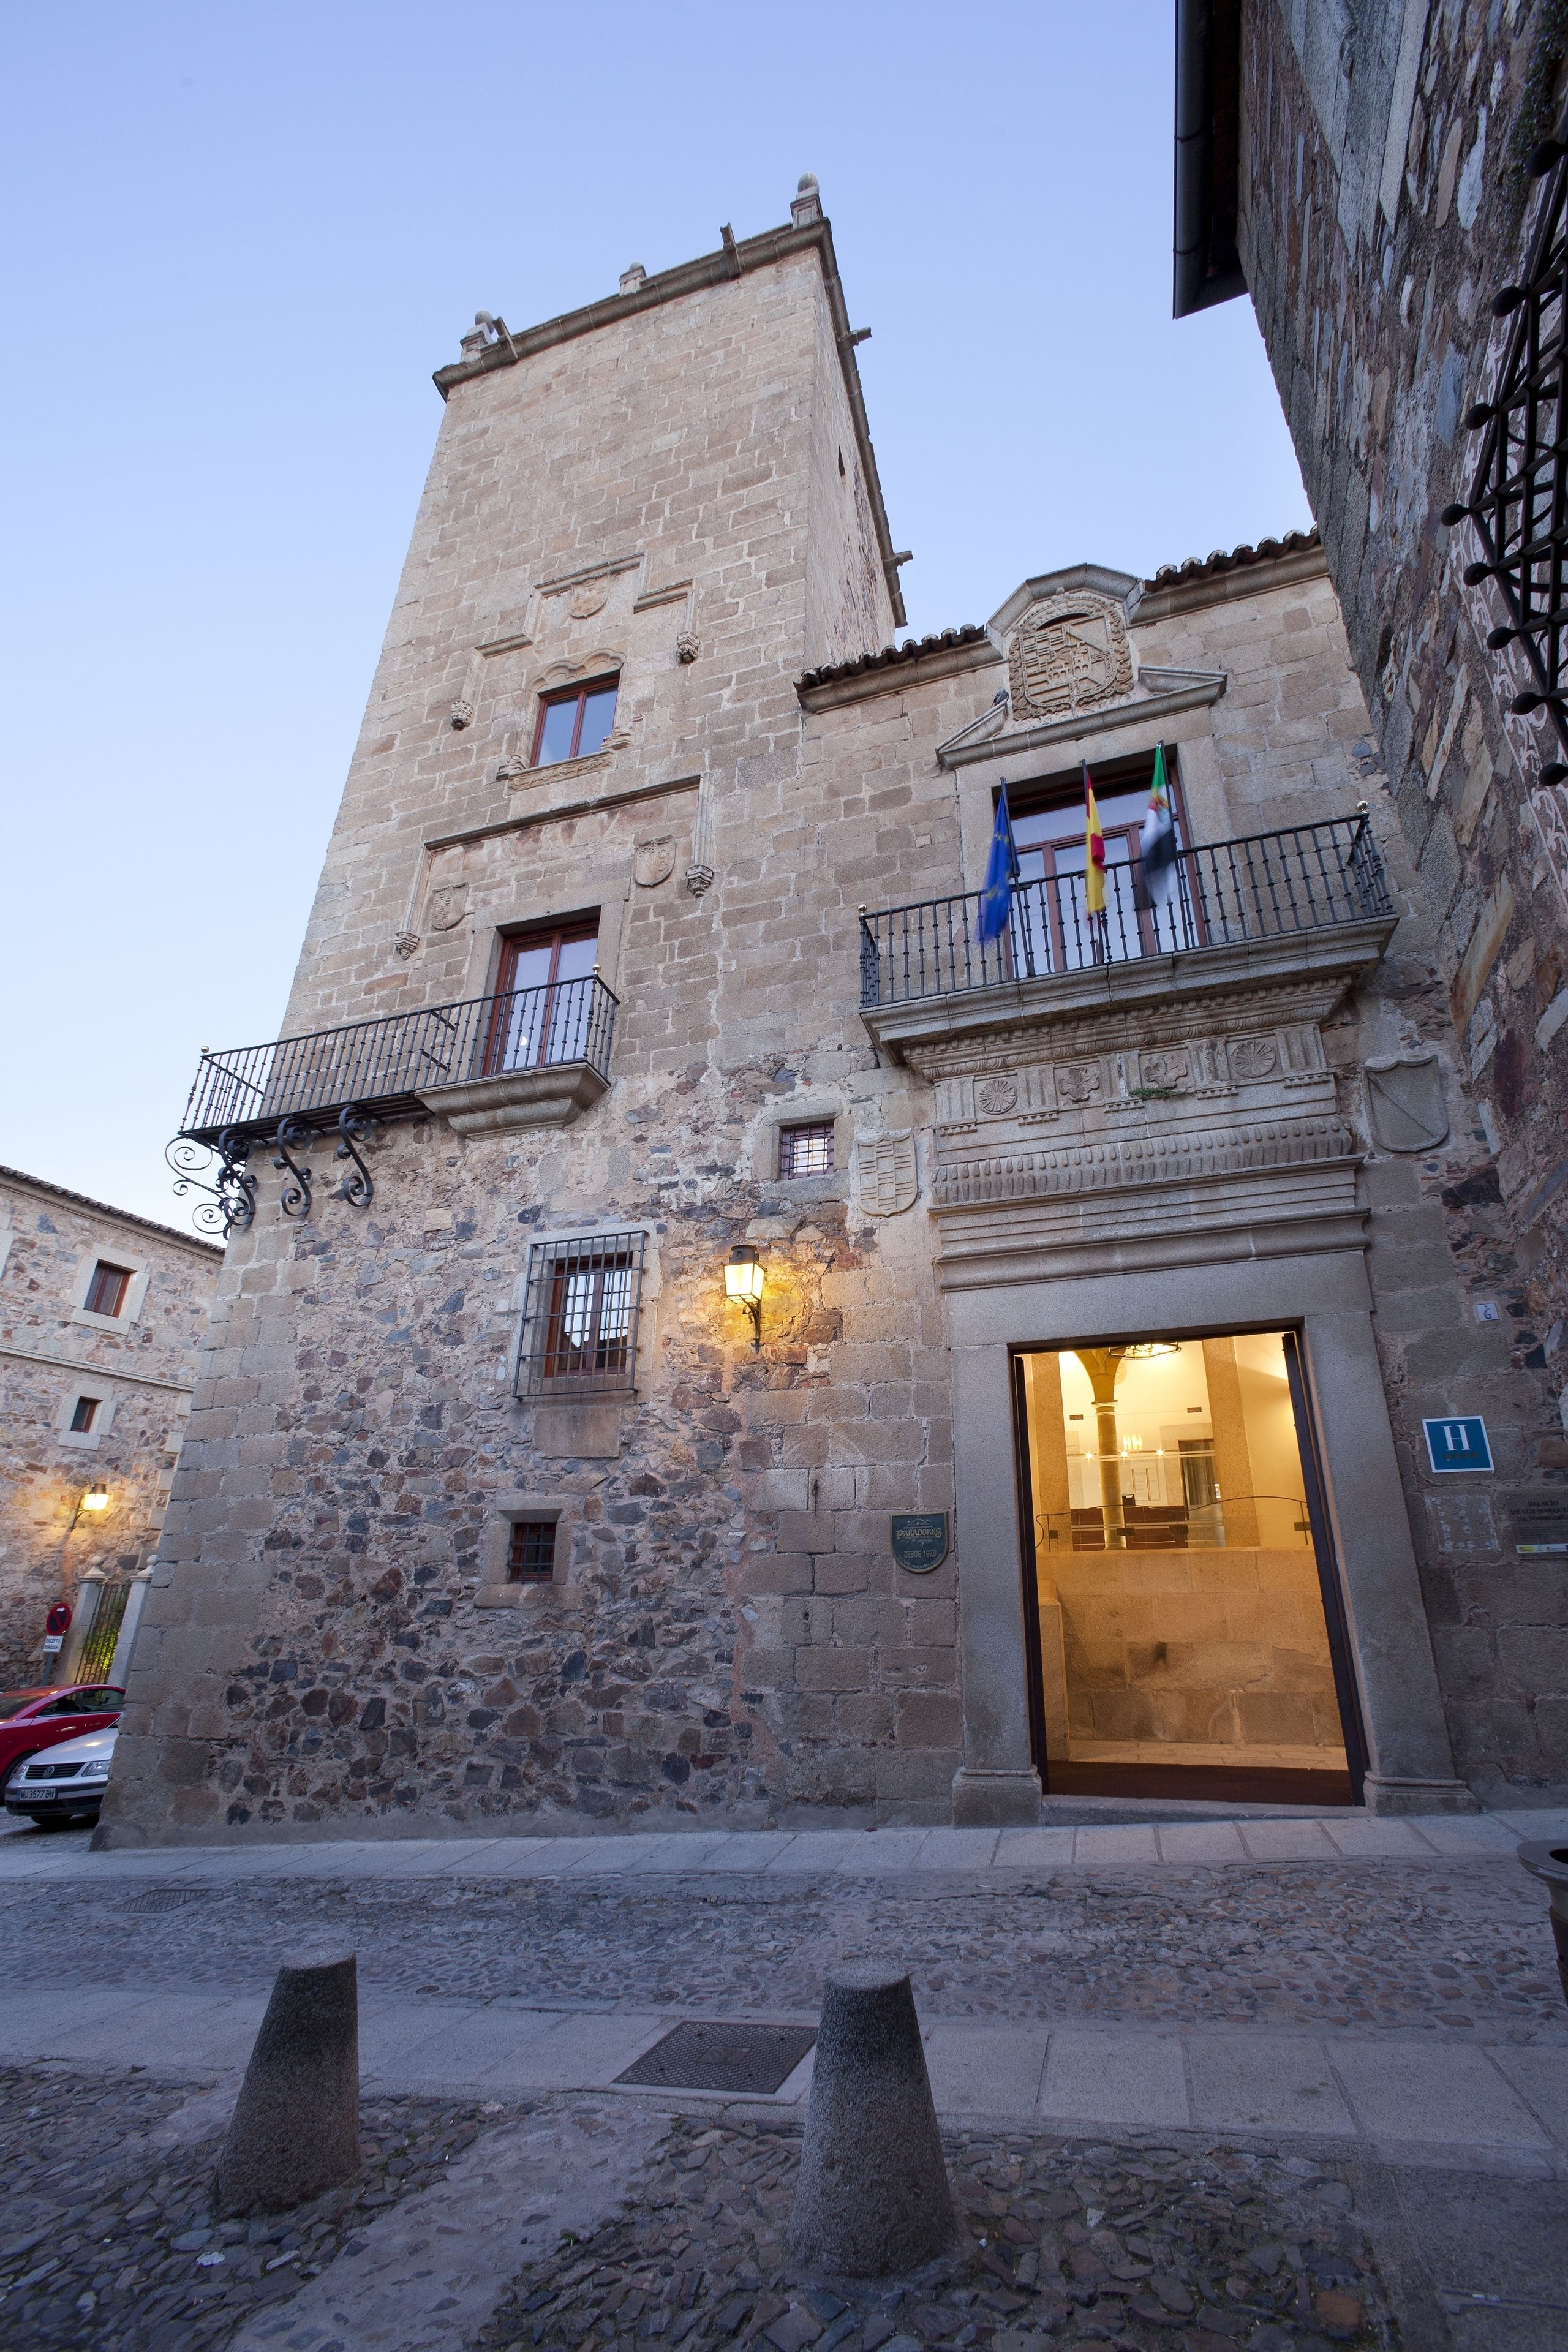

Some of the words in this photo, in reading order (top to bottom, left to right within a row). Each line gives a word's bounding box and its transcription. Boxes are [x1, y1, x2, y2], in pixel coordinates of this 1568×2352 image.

[1441, 1424, 1473, 1452] H
[896, 1528, 941, 1540] PARADORES
[29, 1790, 45, 1799] 3577
